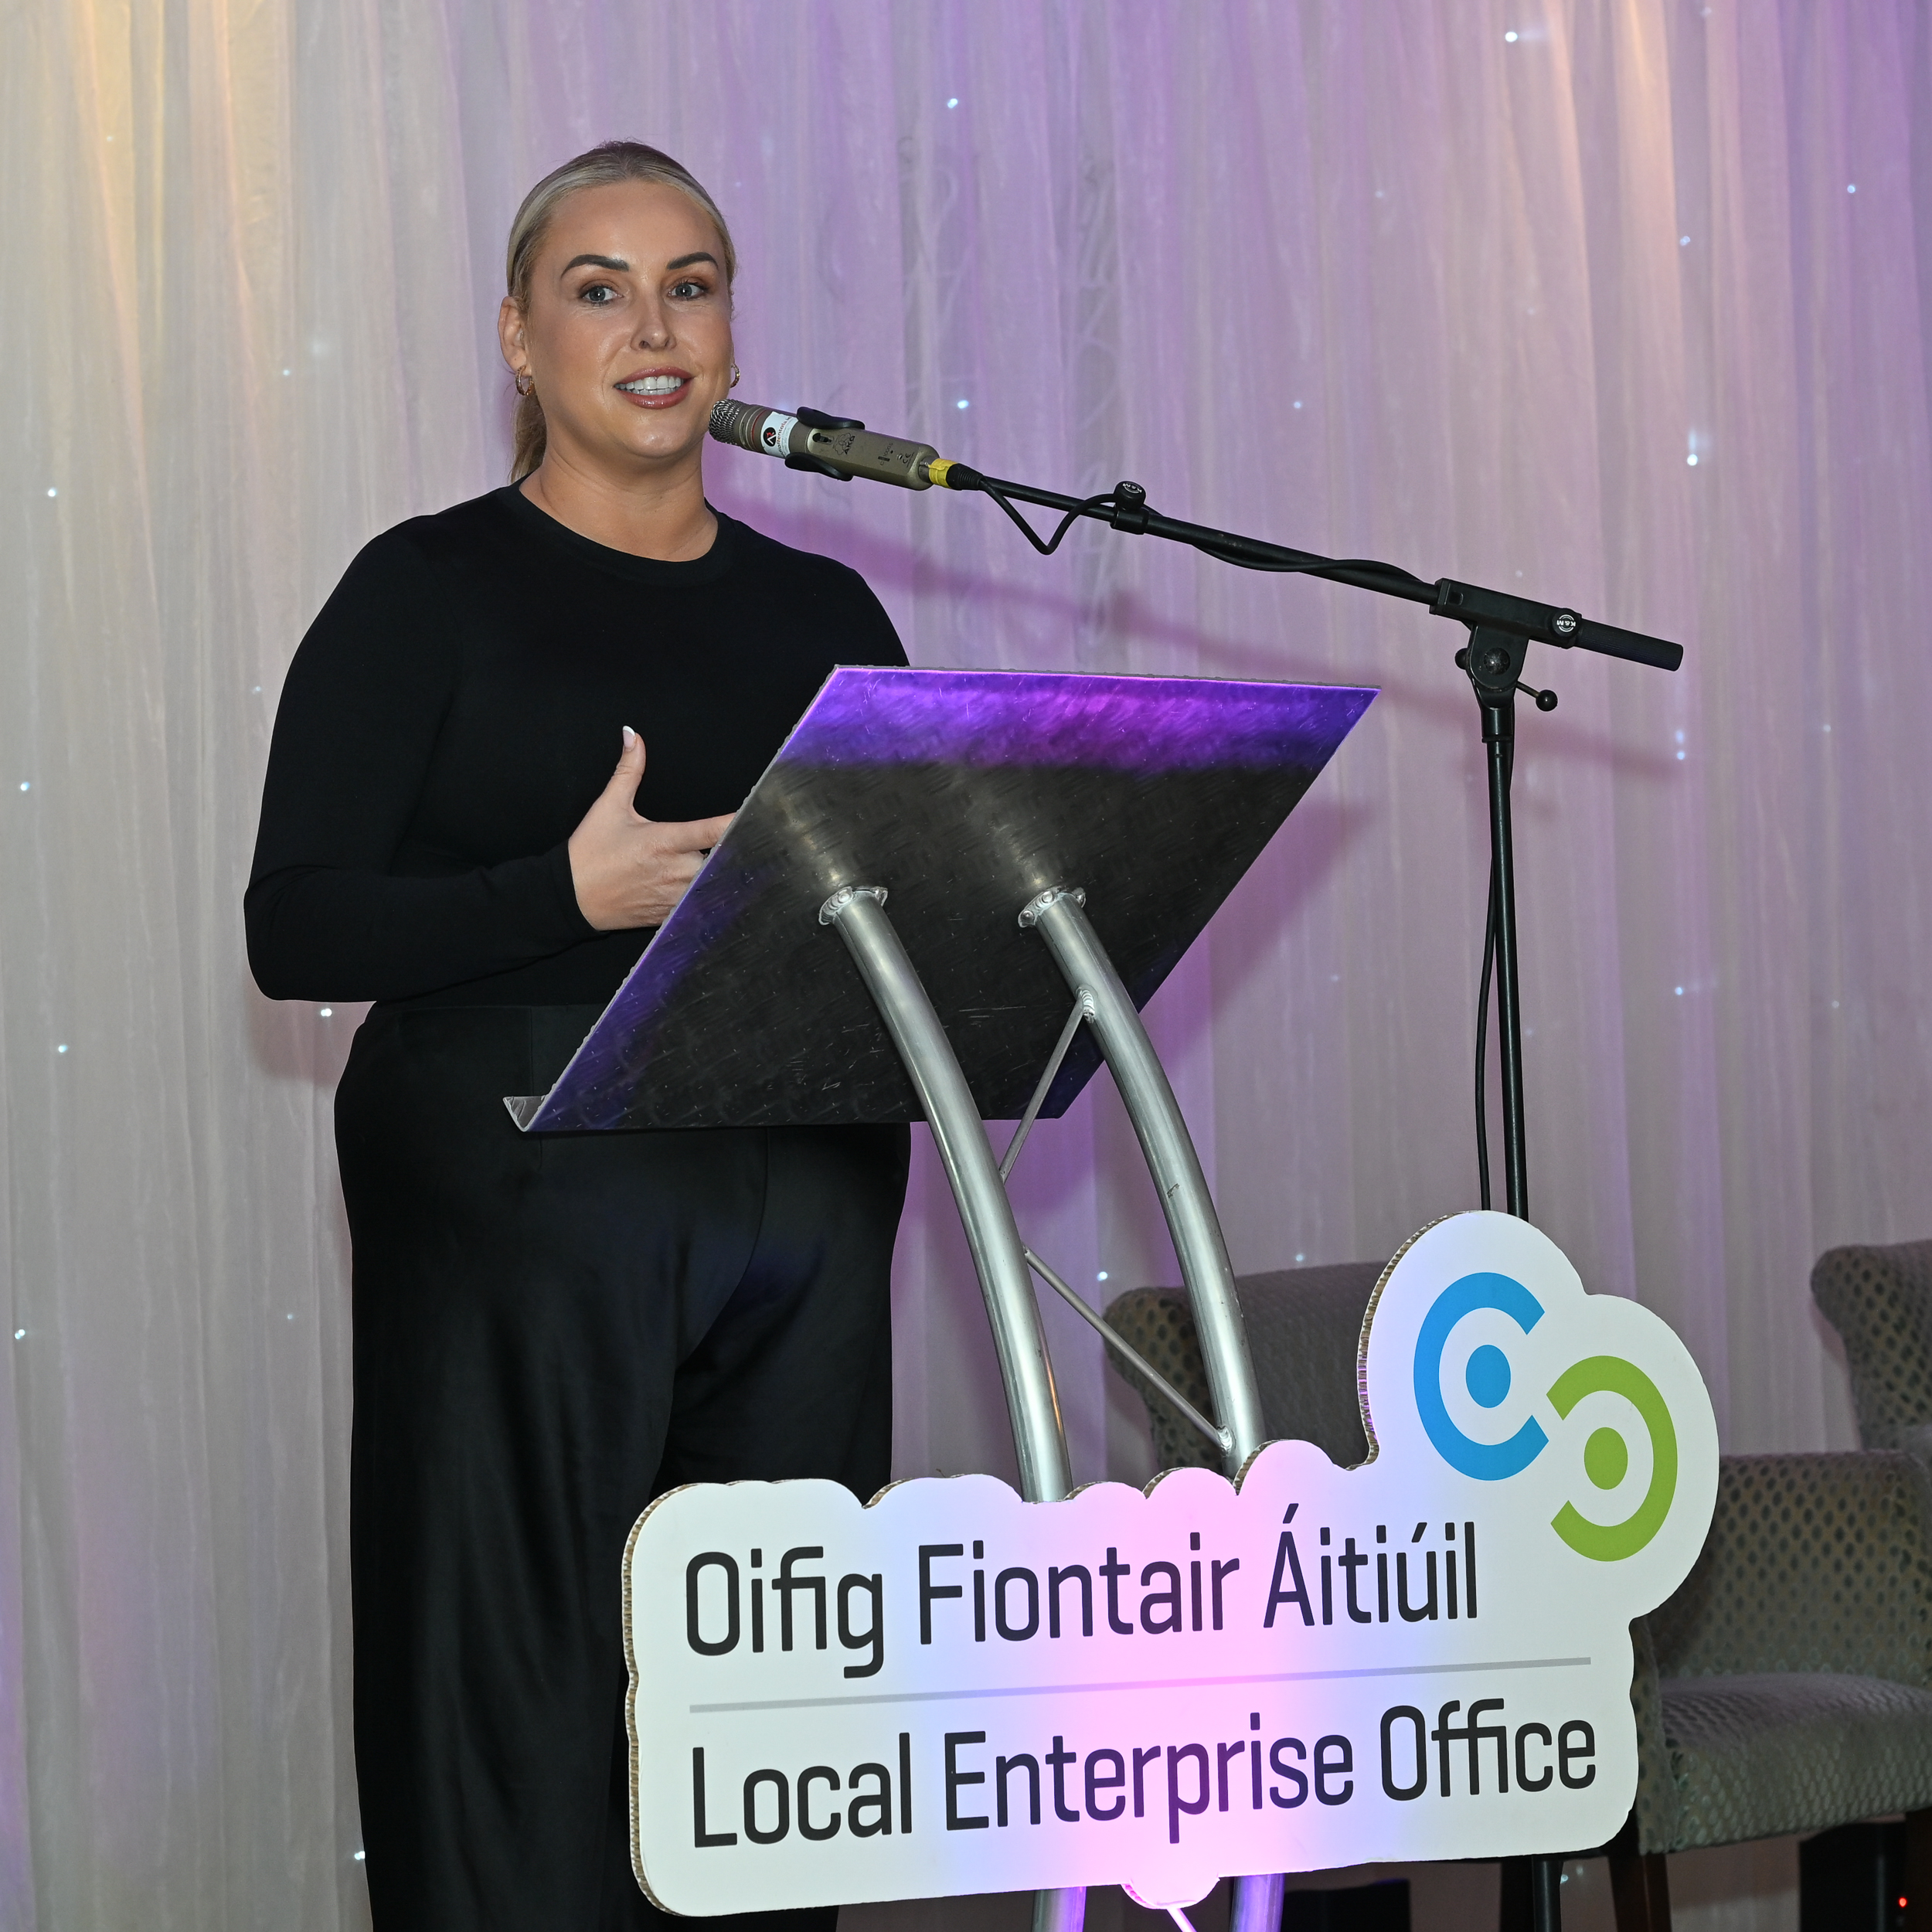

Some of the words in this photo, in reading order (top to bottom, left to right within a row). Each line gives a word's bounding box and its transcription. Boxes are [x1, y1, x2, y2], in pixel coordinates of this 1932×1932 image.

[844, 436, 855, 454] AKG
[685, 1546, 883, 1679] Oifig
[918, 1532, 1240, 1645] Fiontair
[1263, 1503, 1478, 1628] Áitiúil
[692, 1732, 912, 1848] Local
[944, 1712, 1353, 1844] Enterprise
[1379, 1698, 1596, 1801] Office
